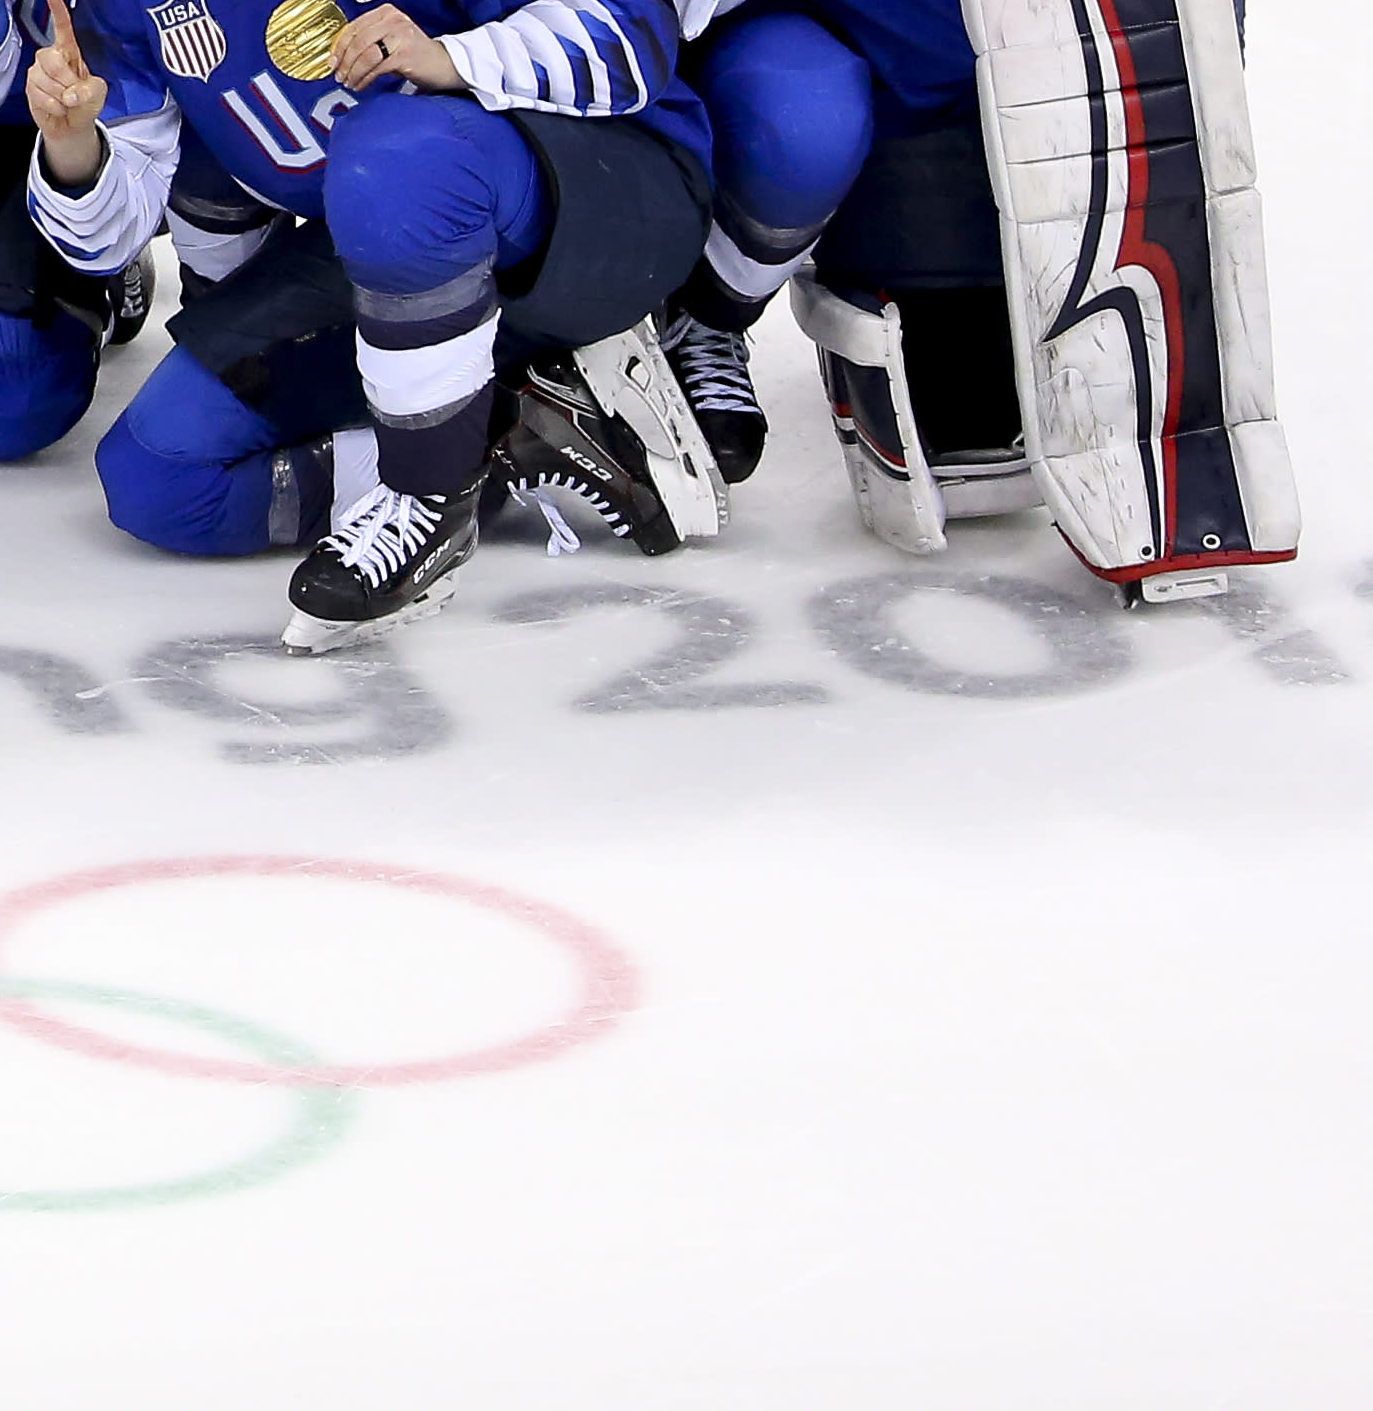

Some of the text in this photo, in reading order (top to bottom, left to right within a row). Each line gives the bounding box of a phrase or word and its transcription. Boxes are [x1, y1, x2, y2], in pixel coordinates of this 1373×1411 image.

[160, 0, 202, 27] USA
[559, 445, 614, 482] CCM
[412, 537, 452, 585] CCM
